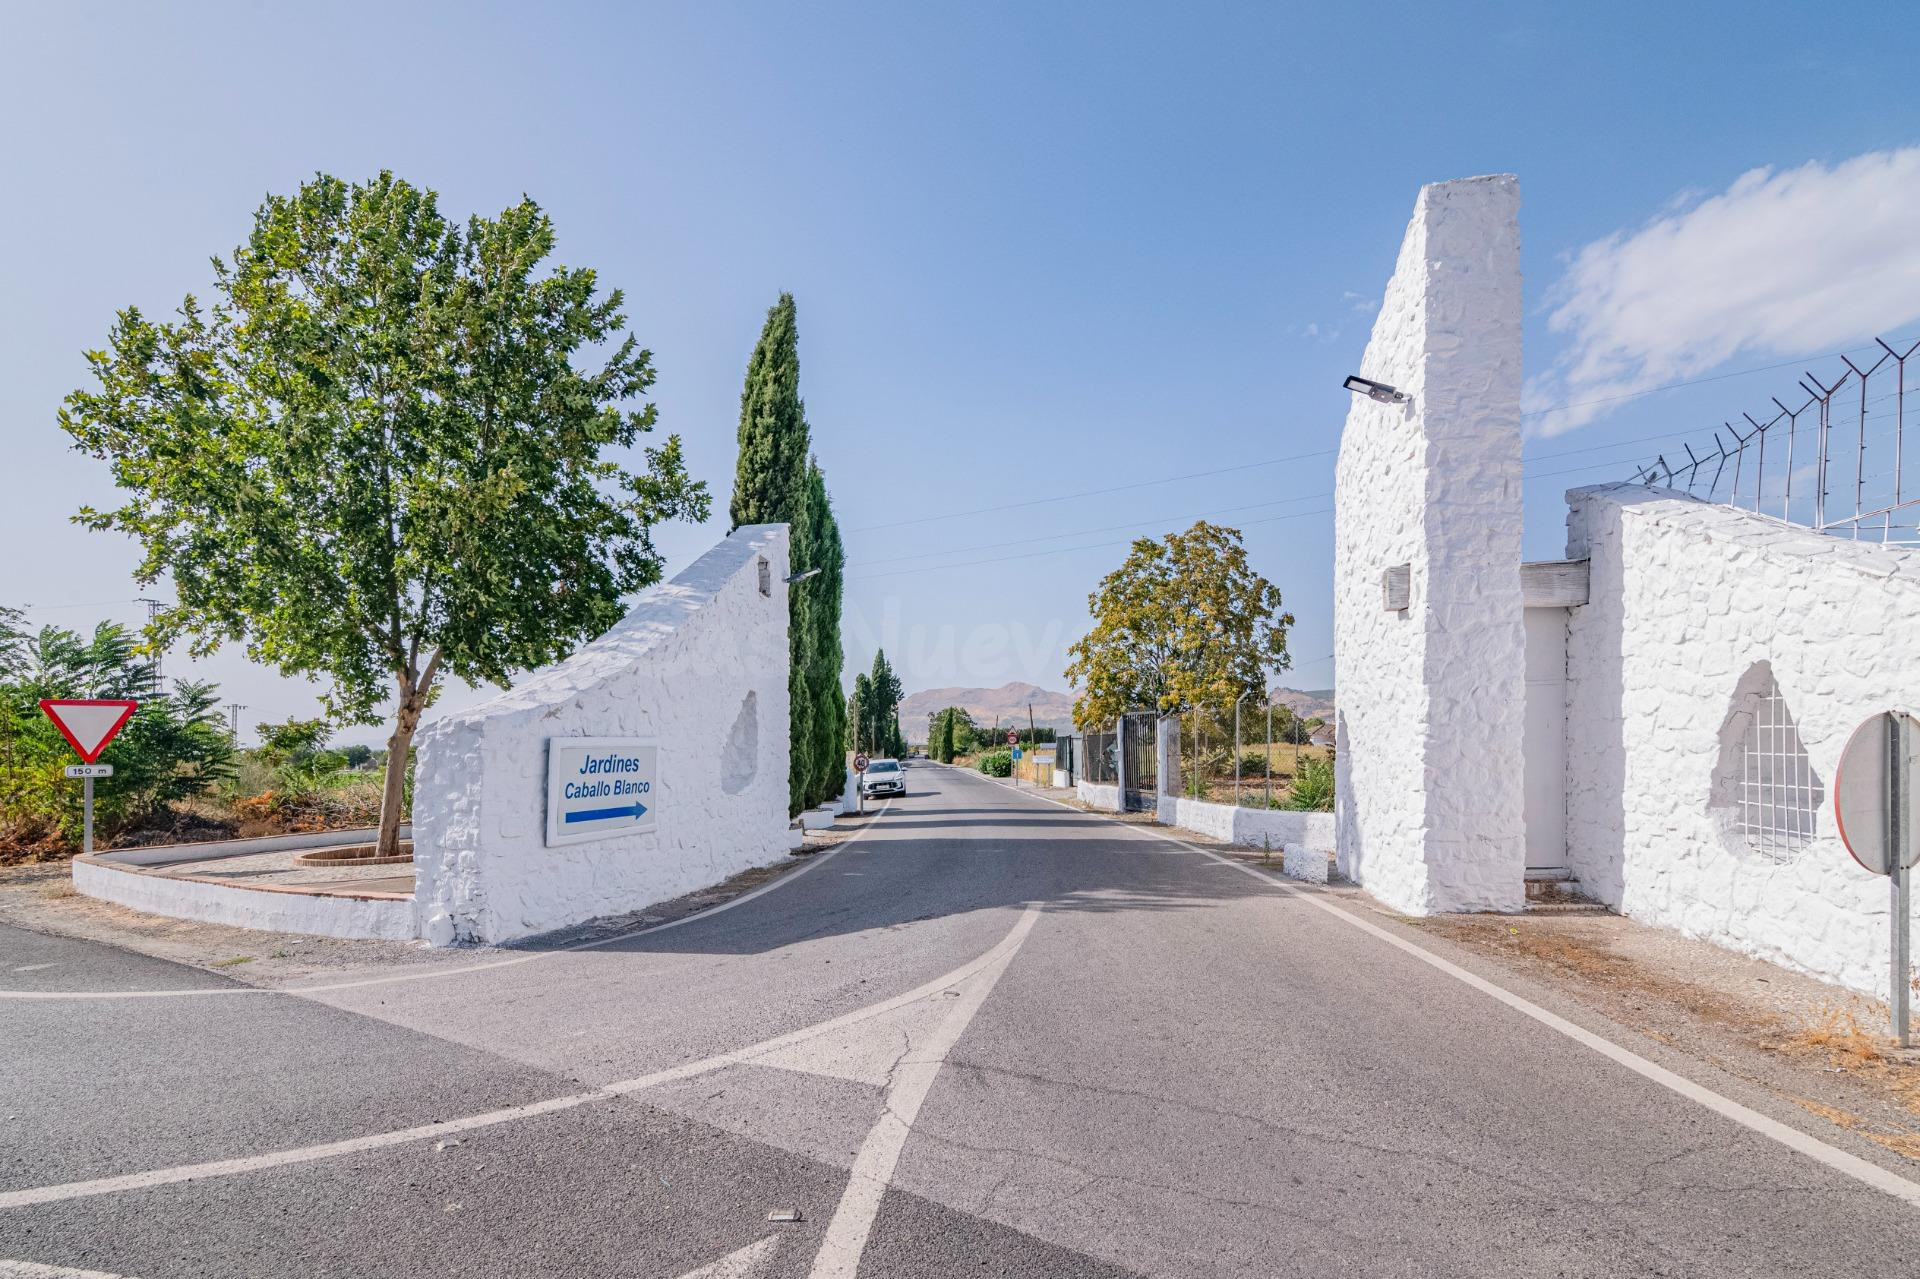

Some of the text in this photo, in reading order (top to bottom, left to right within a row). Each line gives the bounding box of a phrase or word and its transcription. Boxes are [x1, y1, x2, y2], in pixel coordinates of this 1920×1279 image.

[73, 767, 92, 775] 150
[579, 754, 640, 775] Jardines
[565, 779, 650, 799] Caballo Blanco
